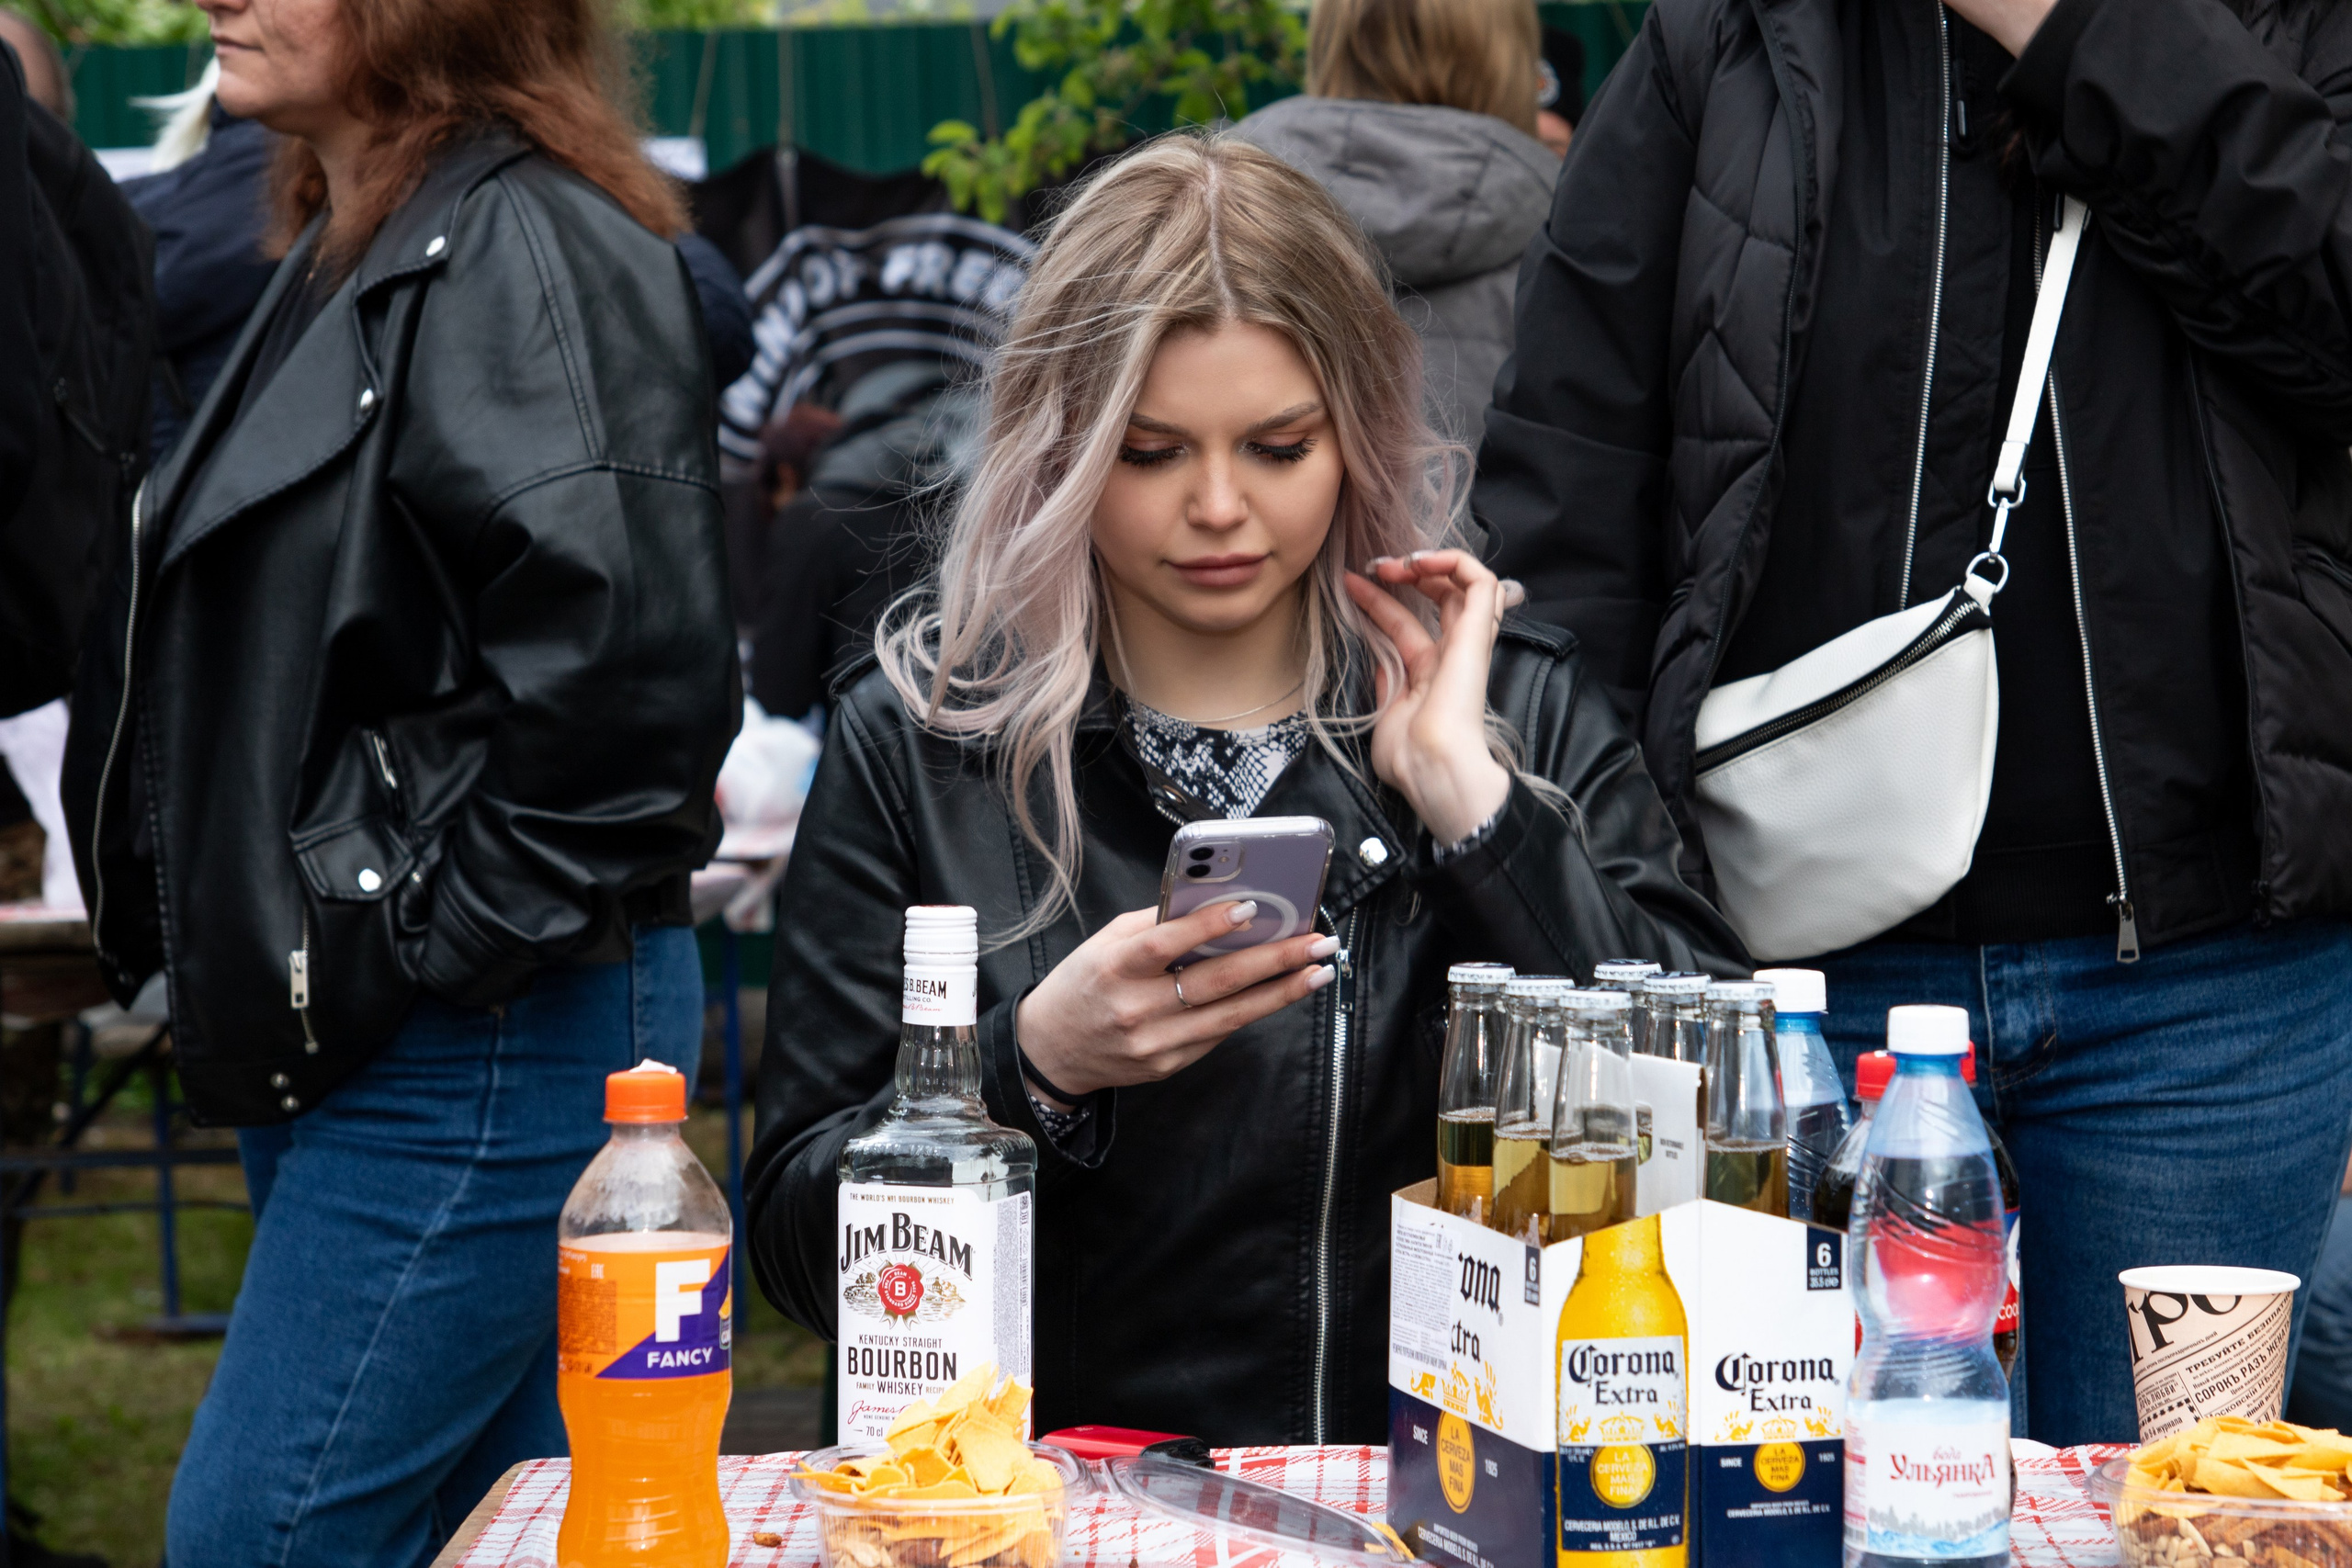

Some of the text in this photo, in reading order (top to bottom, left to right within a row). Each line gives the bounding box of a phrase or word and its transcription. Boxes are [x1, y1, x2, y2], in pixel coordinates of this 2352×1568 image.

[916, 979, 947, 999] BEAM
[840, 1212, 973, 1281] JIM BEAM
[1817, 1242, 1831, 1267] 6
[1529, 1257, 1537, 1282] 6
[895, 1281, 906, 1296] B
[1458, 1252, 1500, 1314] ona
[655, 1258, 711, 1343] F
[859, 1334, 942, 1348] KENTUCKY STRAIGHT
[647, 1346, 713, 1368] FANCY
[848, 1346, 956, 1381] BOURBON
[2185, 1338, 2245, 1374] ТРЕБУЙТЕ
[1569, 1345, 1675, 1388] Corona
[1715, 1352, 1834, 1396] Corona
[856, 1382, 875, 1390] FAMILY
[877, 1381, 923, 1395] WHISKEY
[2195, 1374, 2240, 1403] СОРОКЪ
[2240, 1354, 2267, 1378] РАЗЪ
[1596, 1381, 1658, 1405] Extra
[1750, 1388, 1811, 1412] Extra
[866, 1426, 883, 1437] 70 cl
[1413, 1425, 1428, 1445] SINCE
[1450, 1425, 1460, 1442] LA
[2157, 1417, 2183, 1434] журнала
[1441, 1439, 1471, 1463] CERVEZA
[1614, 1452, 1629, 1462] LA
[1485, 1458, 1498, 1478] 1925
[1597, 1462, 1648, 1474] CERVEZA
[1720, 1458, 1742, 1468] SINCE
[1449, 1478, 1464, 1495] FINA
[1609, 1485, 1635, 1496] FINA
[1564, 1519, 1602, 1532] CERVECERIA
[1609, 1532, 1637, 1543] MEXICO
